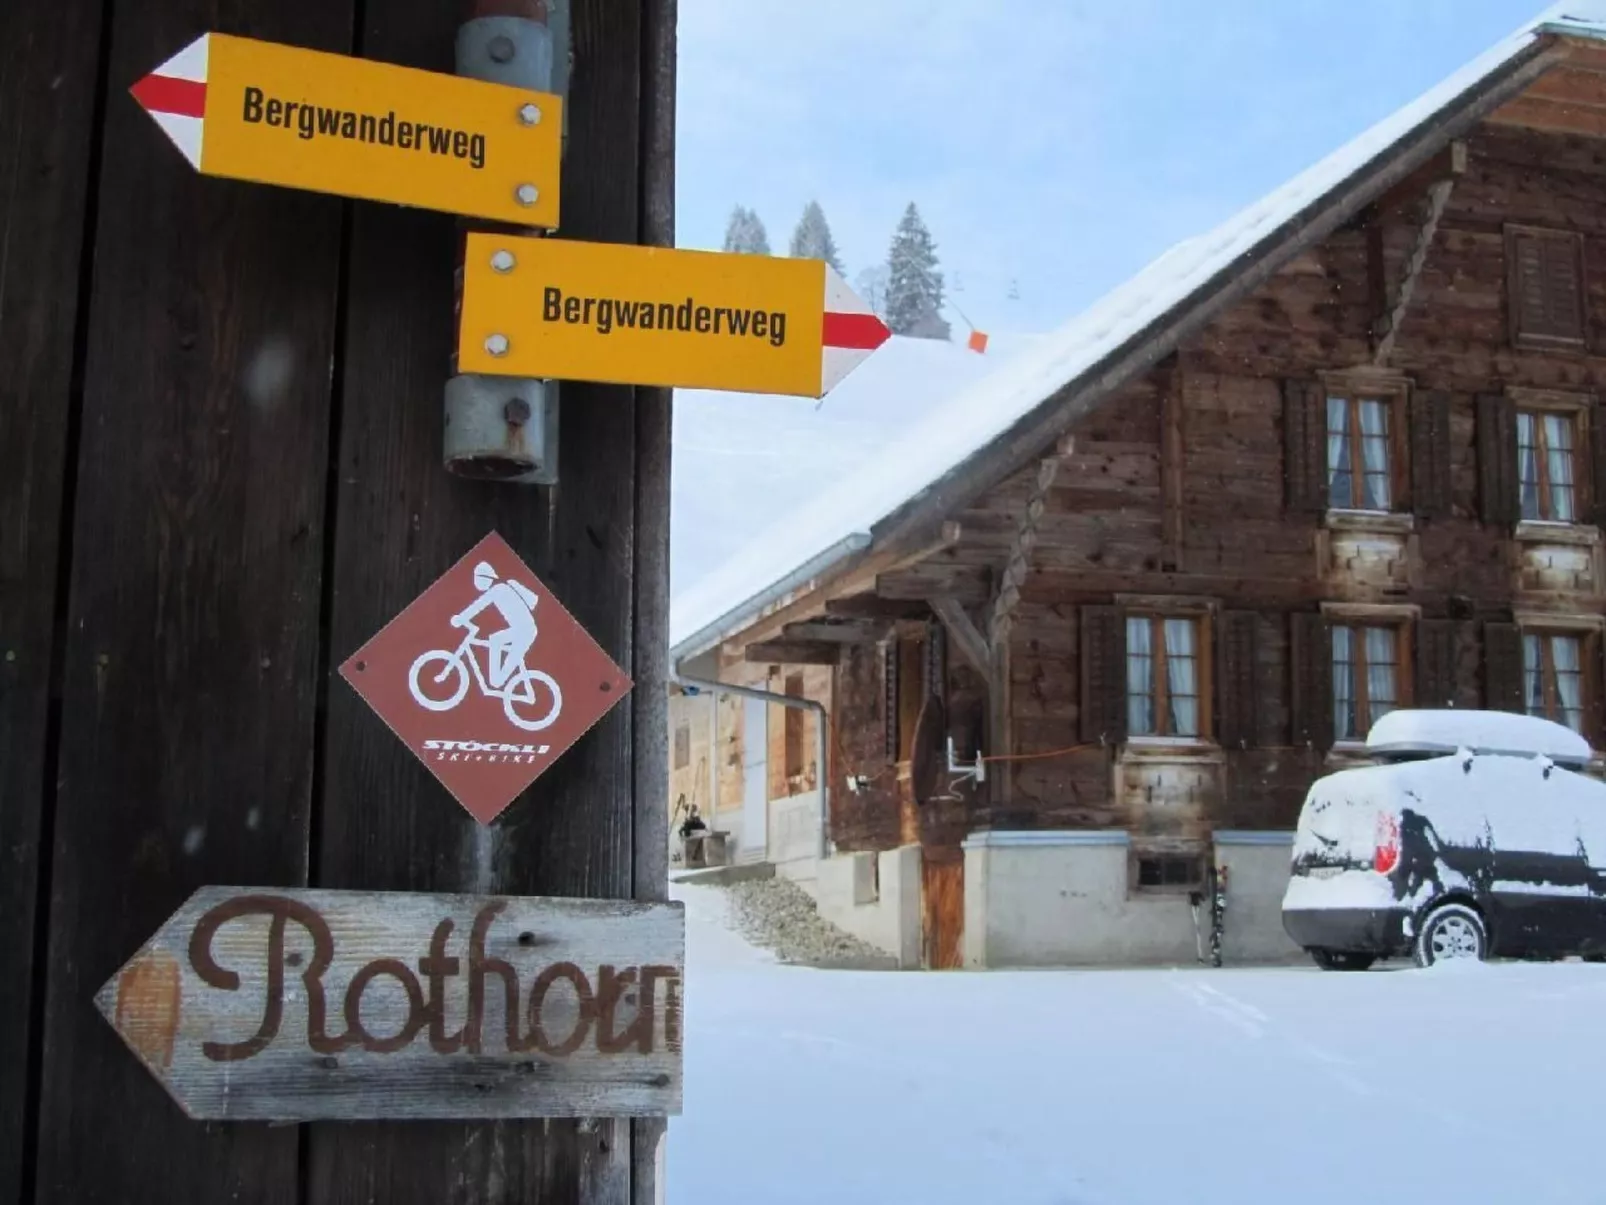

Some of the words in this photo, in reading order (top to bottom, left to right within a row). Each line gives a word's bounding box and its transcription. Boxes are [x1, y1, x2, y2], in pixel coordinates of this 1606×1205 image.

[243, 87, 485, 169] Bergwanderweg
[543, 286, 786, 347] Bergwanderweg
[187, 894, 682, 1062] Rothorn
